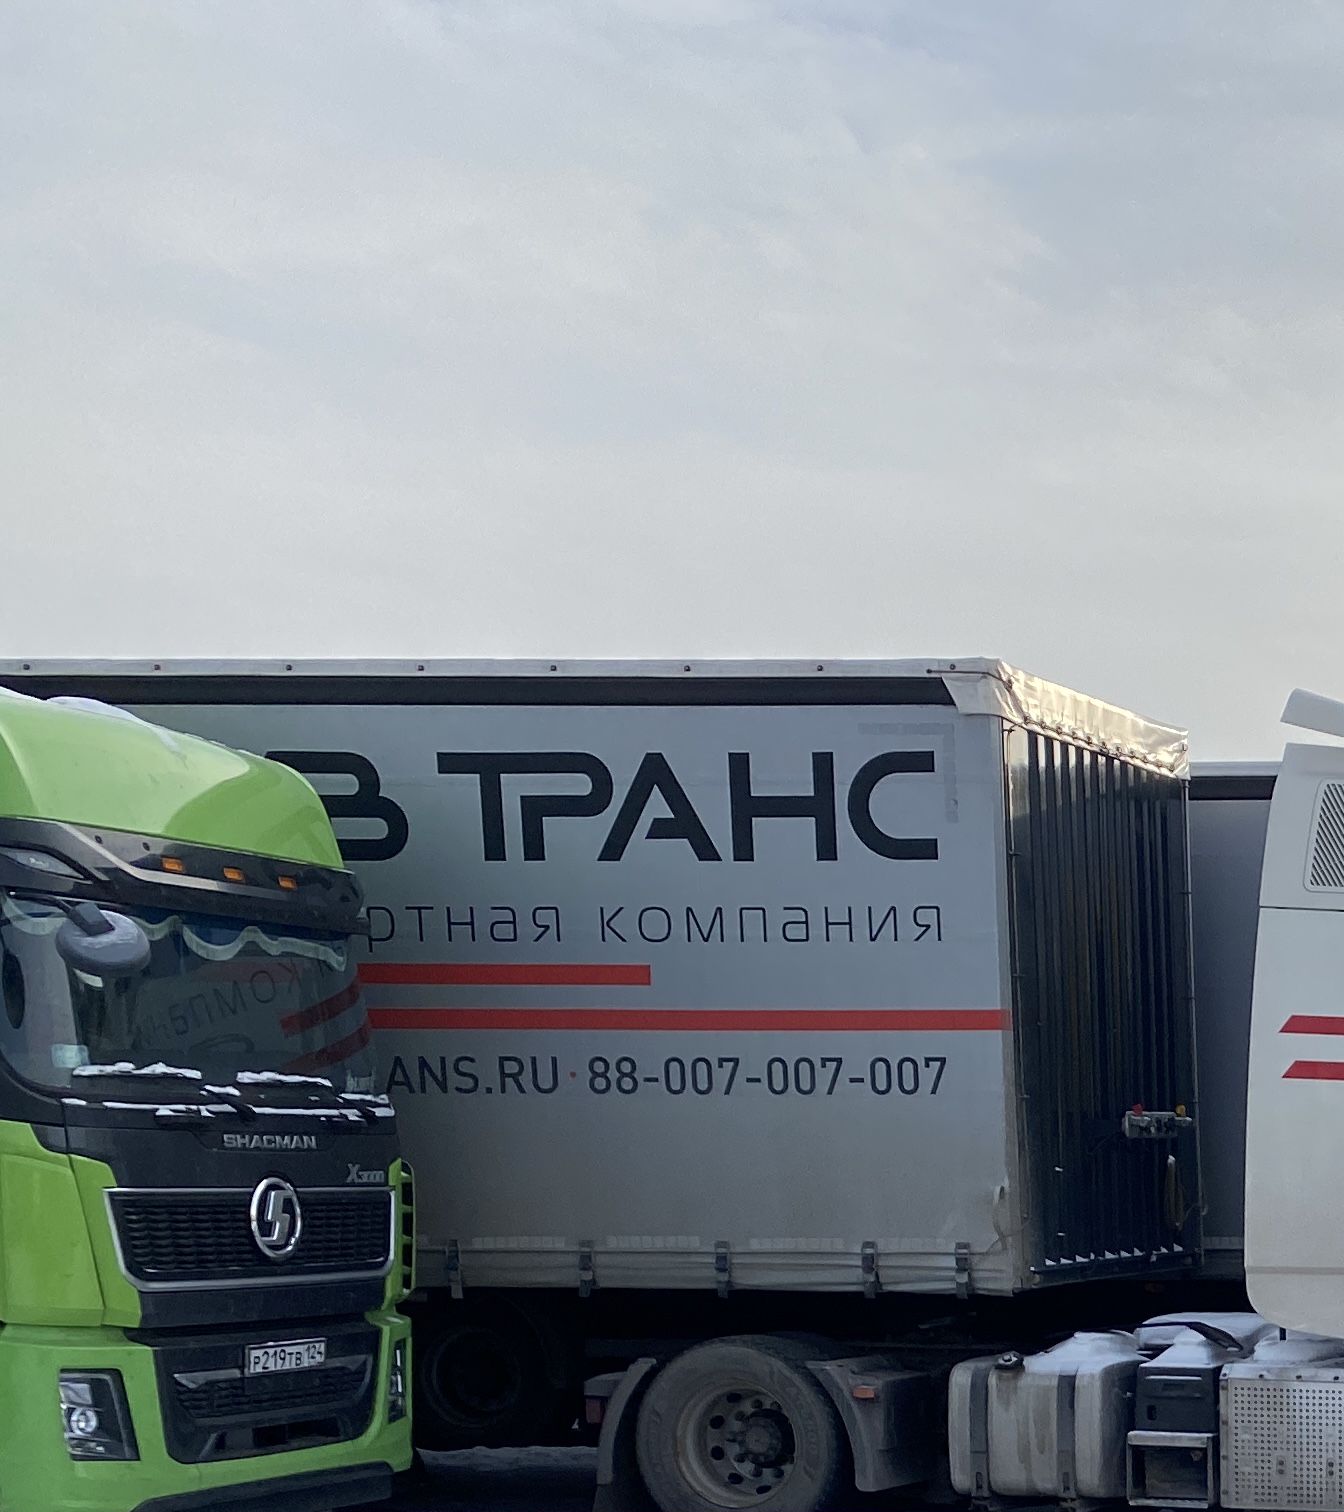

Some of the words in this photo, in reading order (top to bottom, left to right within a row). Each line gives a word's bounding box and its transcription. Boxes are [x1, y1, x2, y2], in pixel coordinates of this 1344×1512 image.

[436, 751, 939, 862] ТРАНС
[601, 906, 943, 943] компания
[588, 1056, 948, 1095] 88-007-007-007
[223, 1133, 318, 1149] SHACMAN
[305, 1343, 324, 1360] 124
